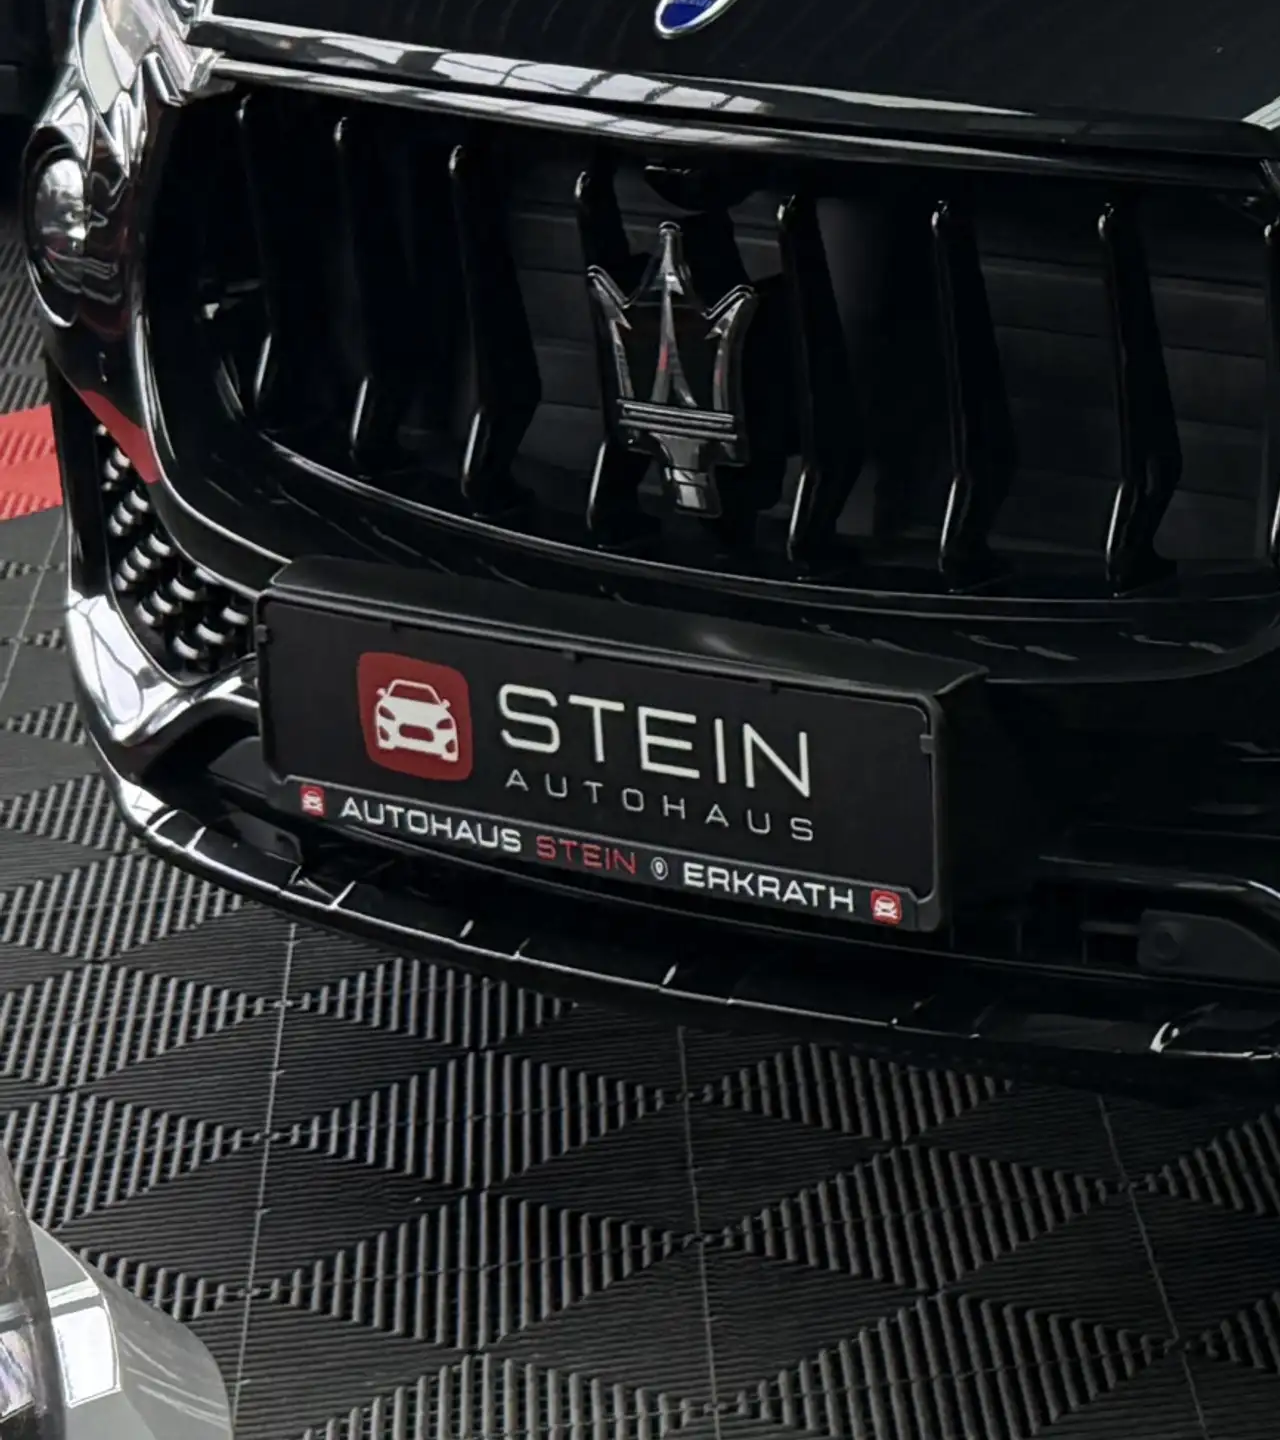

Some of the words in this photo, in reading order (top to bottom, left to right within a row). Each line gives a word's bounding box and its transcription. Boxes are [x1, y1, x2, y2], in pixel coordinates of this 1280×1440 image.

[498, 684, 811, 798] STEIN
[340, 797, 522, 853] AUTOHAUS
[535, 835, 637, 875] STEIN
[682, 862, 855, 913] ERKRATH
[505, 768, 814, 842] AUTOHAUS
